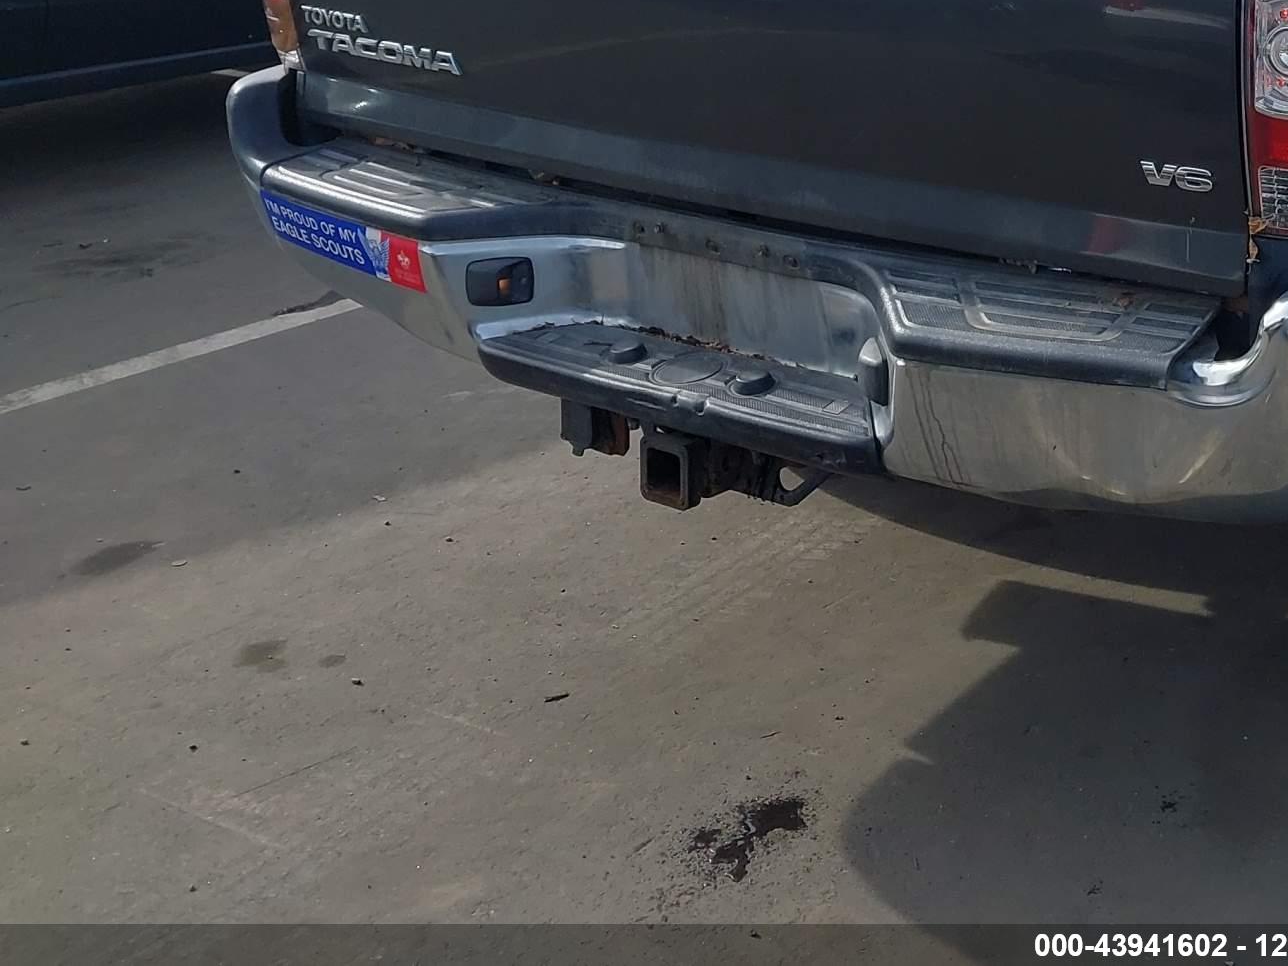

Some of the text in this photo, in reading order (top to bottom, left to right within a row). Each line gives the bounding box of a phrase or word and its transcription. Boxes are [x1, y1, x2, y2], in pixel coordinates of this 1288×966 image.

[301, 5, 368, 33] TOYOTA
[307, 29, 464, 76] TACOMA
[1140, 160, 1213, 192] V6
[264, 198, 359, 244] I'M PROUD OF MY
[271, 216, 365, 265] EAGLE SCOUTS
